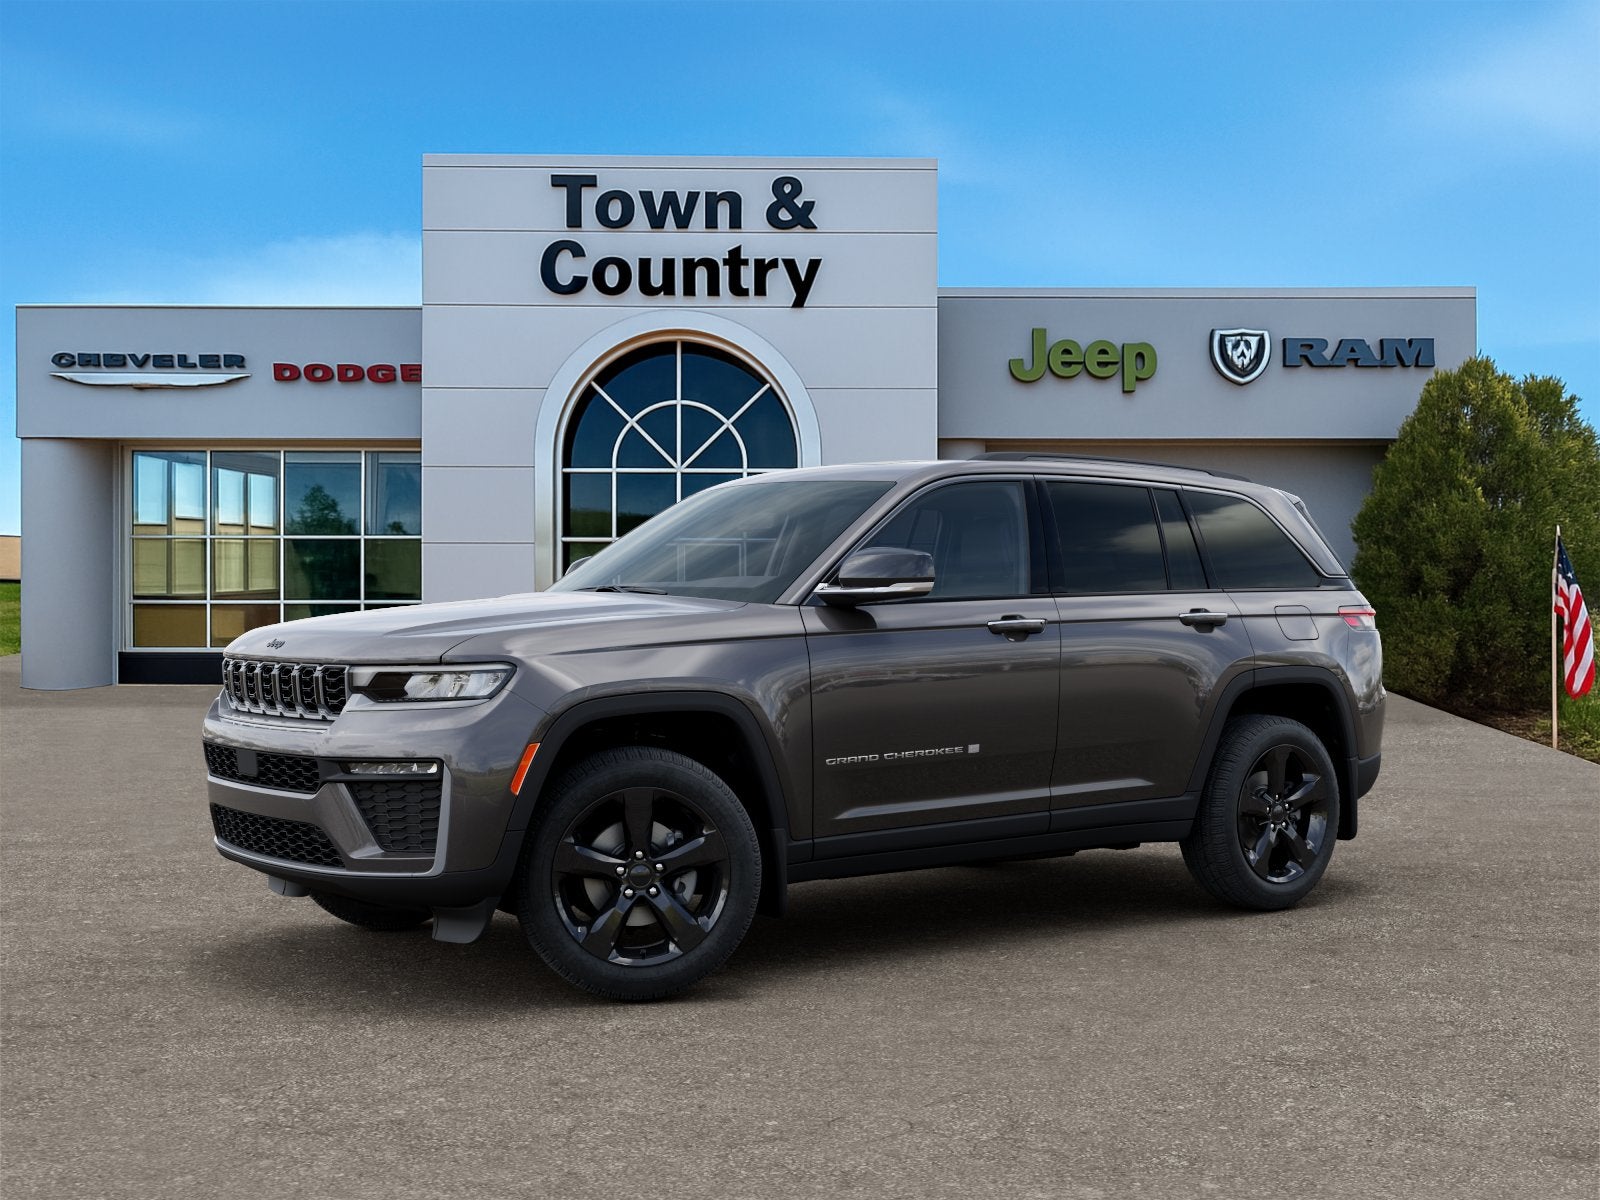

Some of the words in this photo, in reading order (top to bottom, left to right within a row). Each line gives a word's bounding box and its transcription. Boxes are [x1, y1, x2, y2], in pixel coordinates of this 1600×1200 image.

[550, 174, 742, 229] Town
[766, 176, 818, 230] &
[540, 239, 822, 308] Country
[273, 363, 422, 383] DODGE
[1009, 328, 1157, 392] Jeep
[1282, 338, 1435, 368] RAM
[825, 754, 879, 766] GRAND
[883, 746, 964, 760] CHEROKEE
